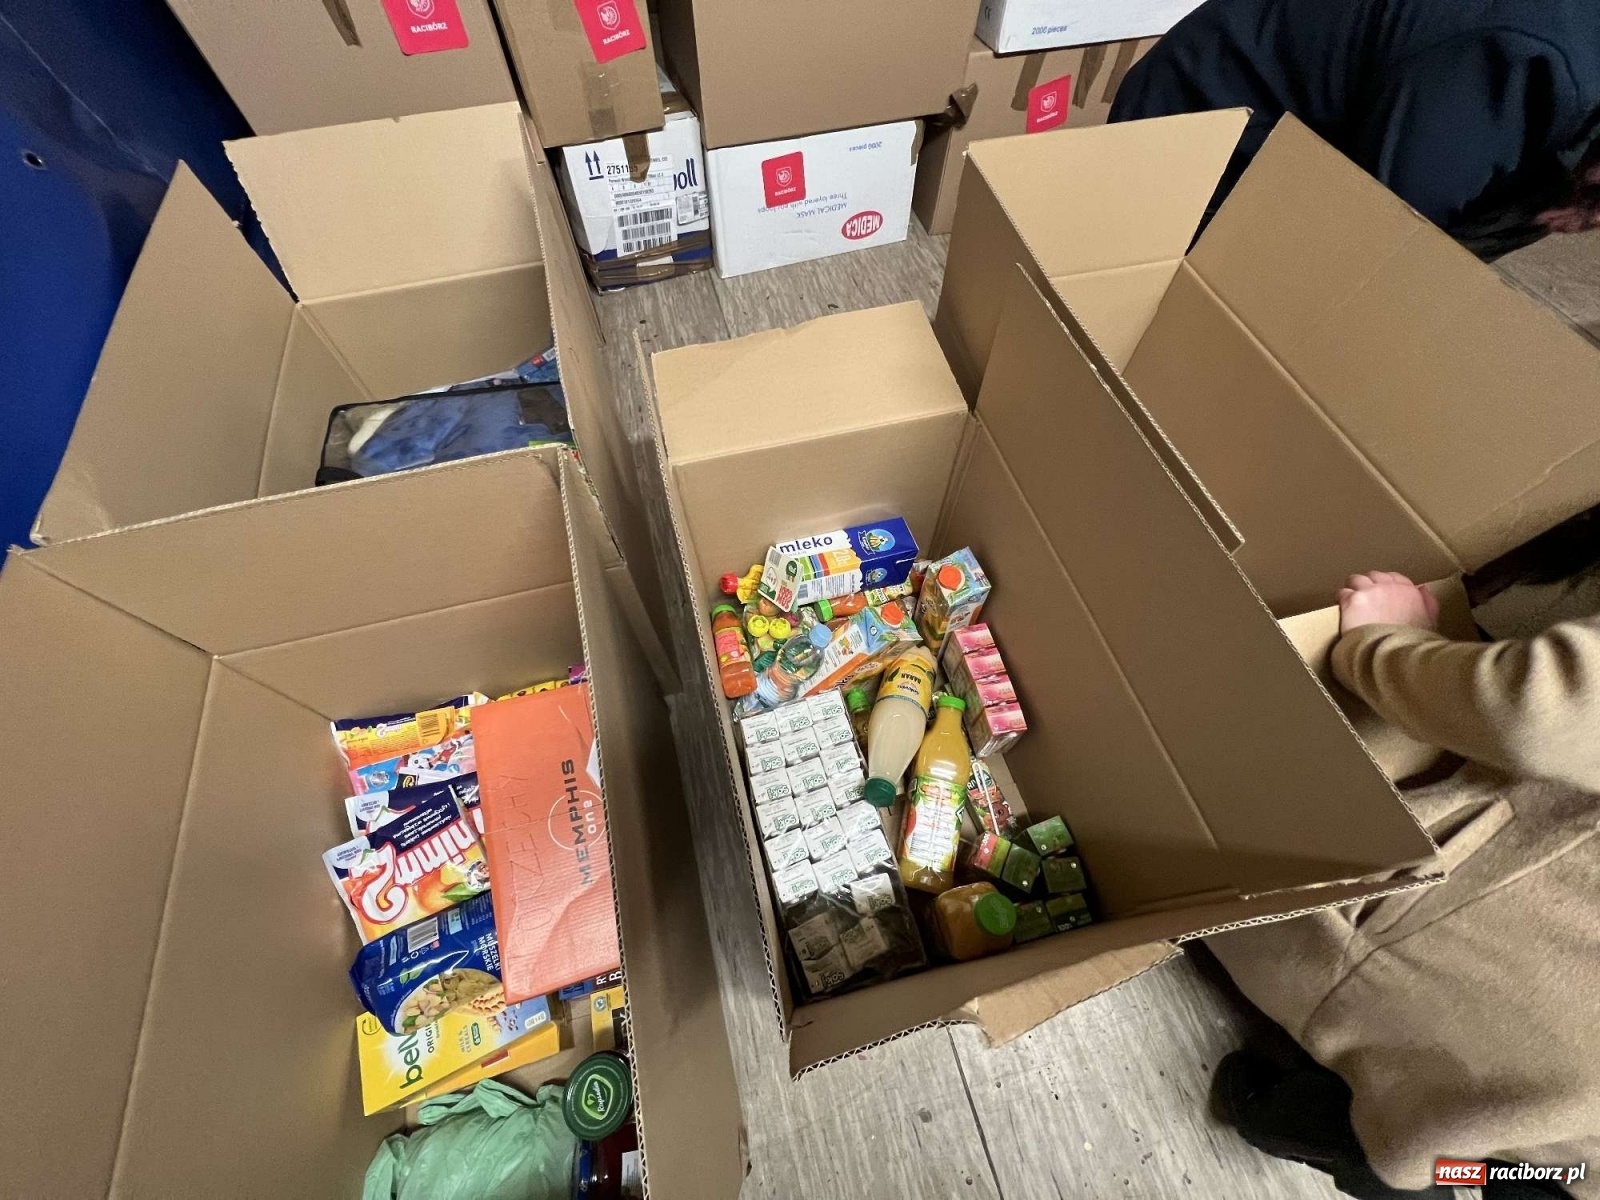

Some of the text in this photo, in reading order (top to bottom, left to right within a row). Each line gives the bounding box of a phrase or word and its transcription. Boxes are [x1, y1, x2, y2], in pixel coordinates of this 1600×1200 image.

[1031, 25, 1068, 35] 2000 pieces
[797, 203, 848, 219] MEDICAL MASK
[846, 215, 881, 237] MEDICA
[780, 536, 833, 553] mleko
[562, 758, 595, 885] MEMPHIS
[583, 799, 597, 835] one
[478, 936, 494, 972] MORSKIE
[485, 932, 501, 971] MUSZELKI
